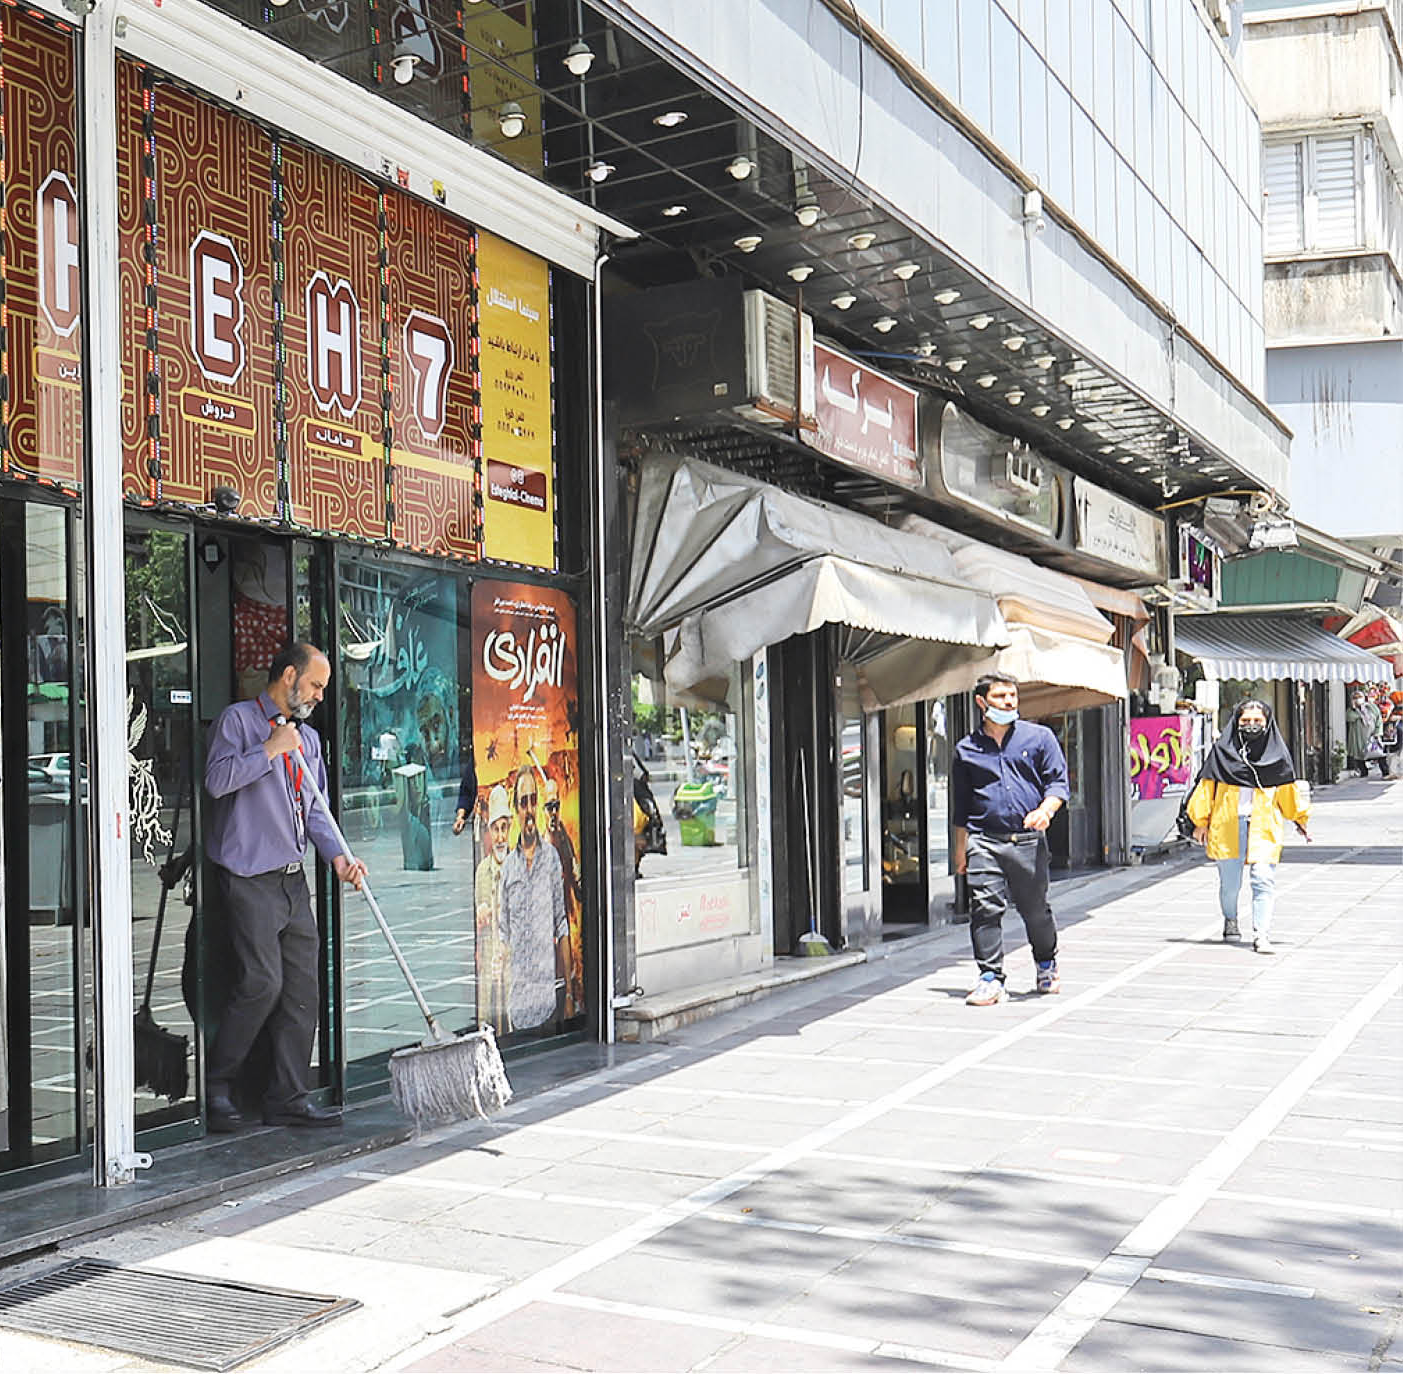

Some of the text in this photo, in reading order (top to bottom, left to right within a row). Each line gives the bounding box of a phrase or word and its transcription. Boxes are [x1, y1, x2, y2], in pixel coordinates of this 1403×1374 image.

[201, 397, 236, 420] فروش
[316, 428, 354, 448] سامانه
[483, 623, 566, 704] انفرادی
